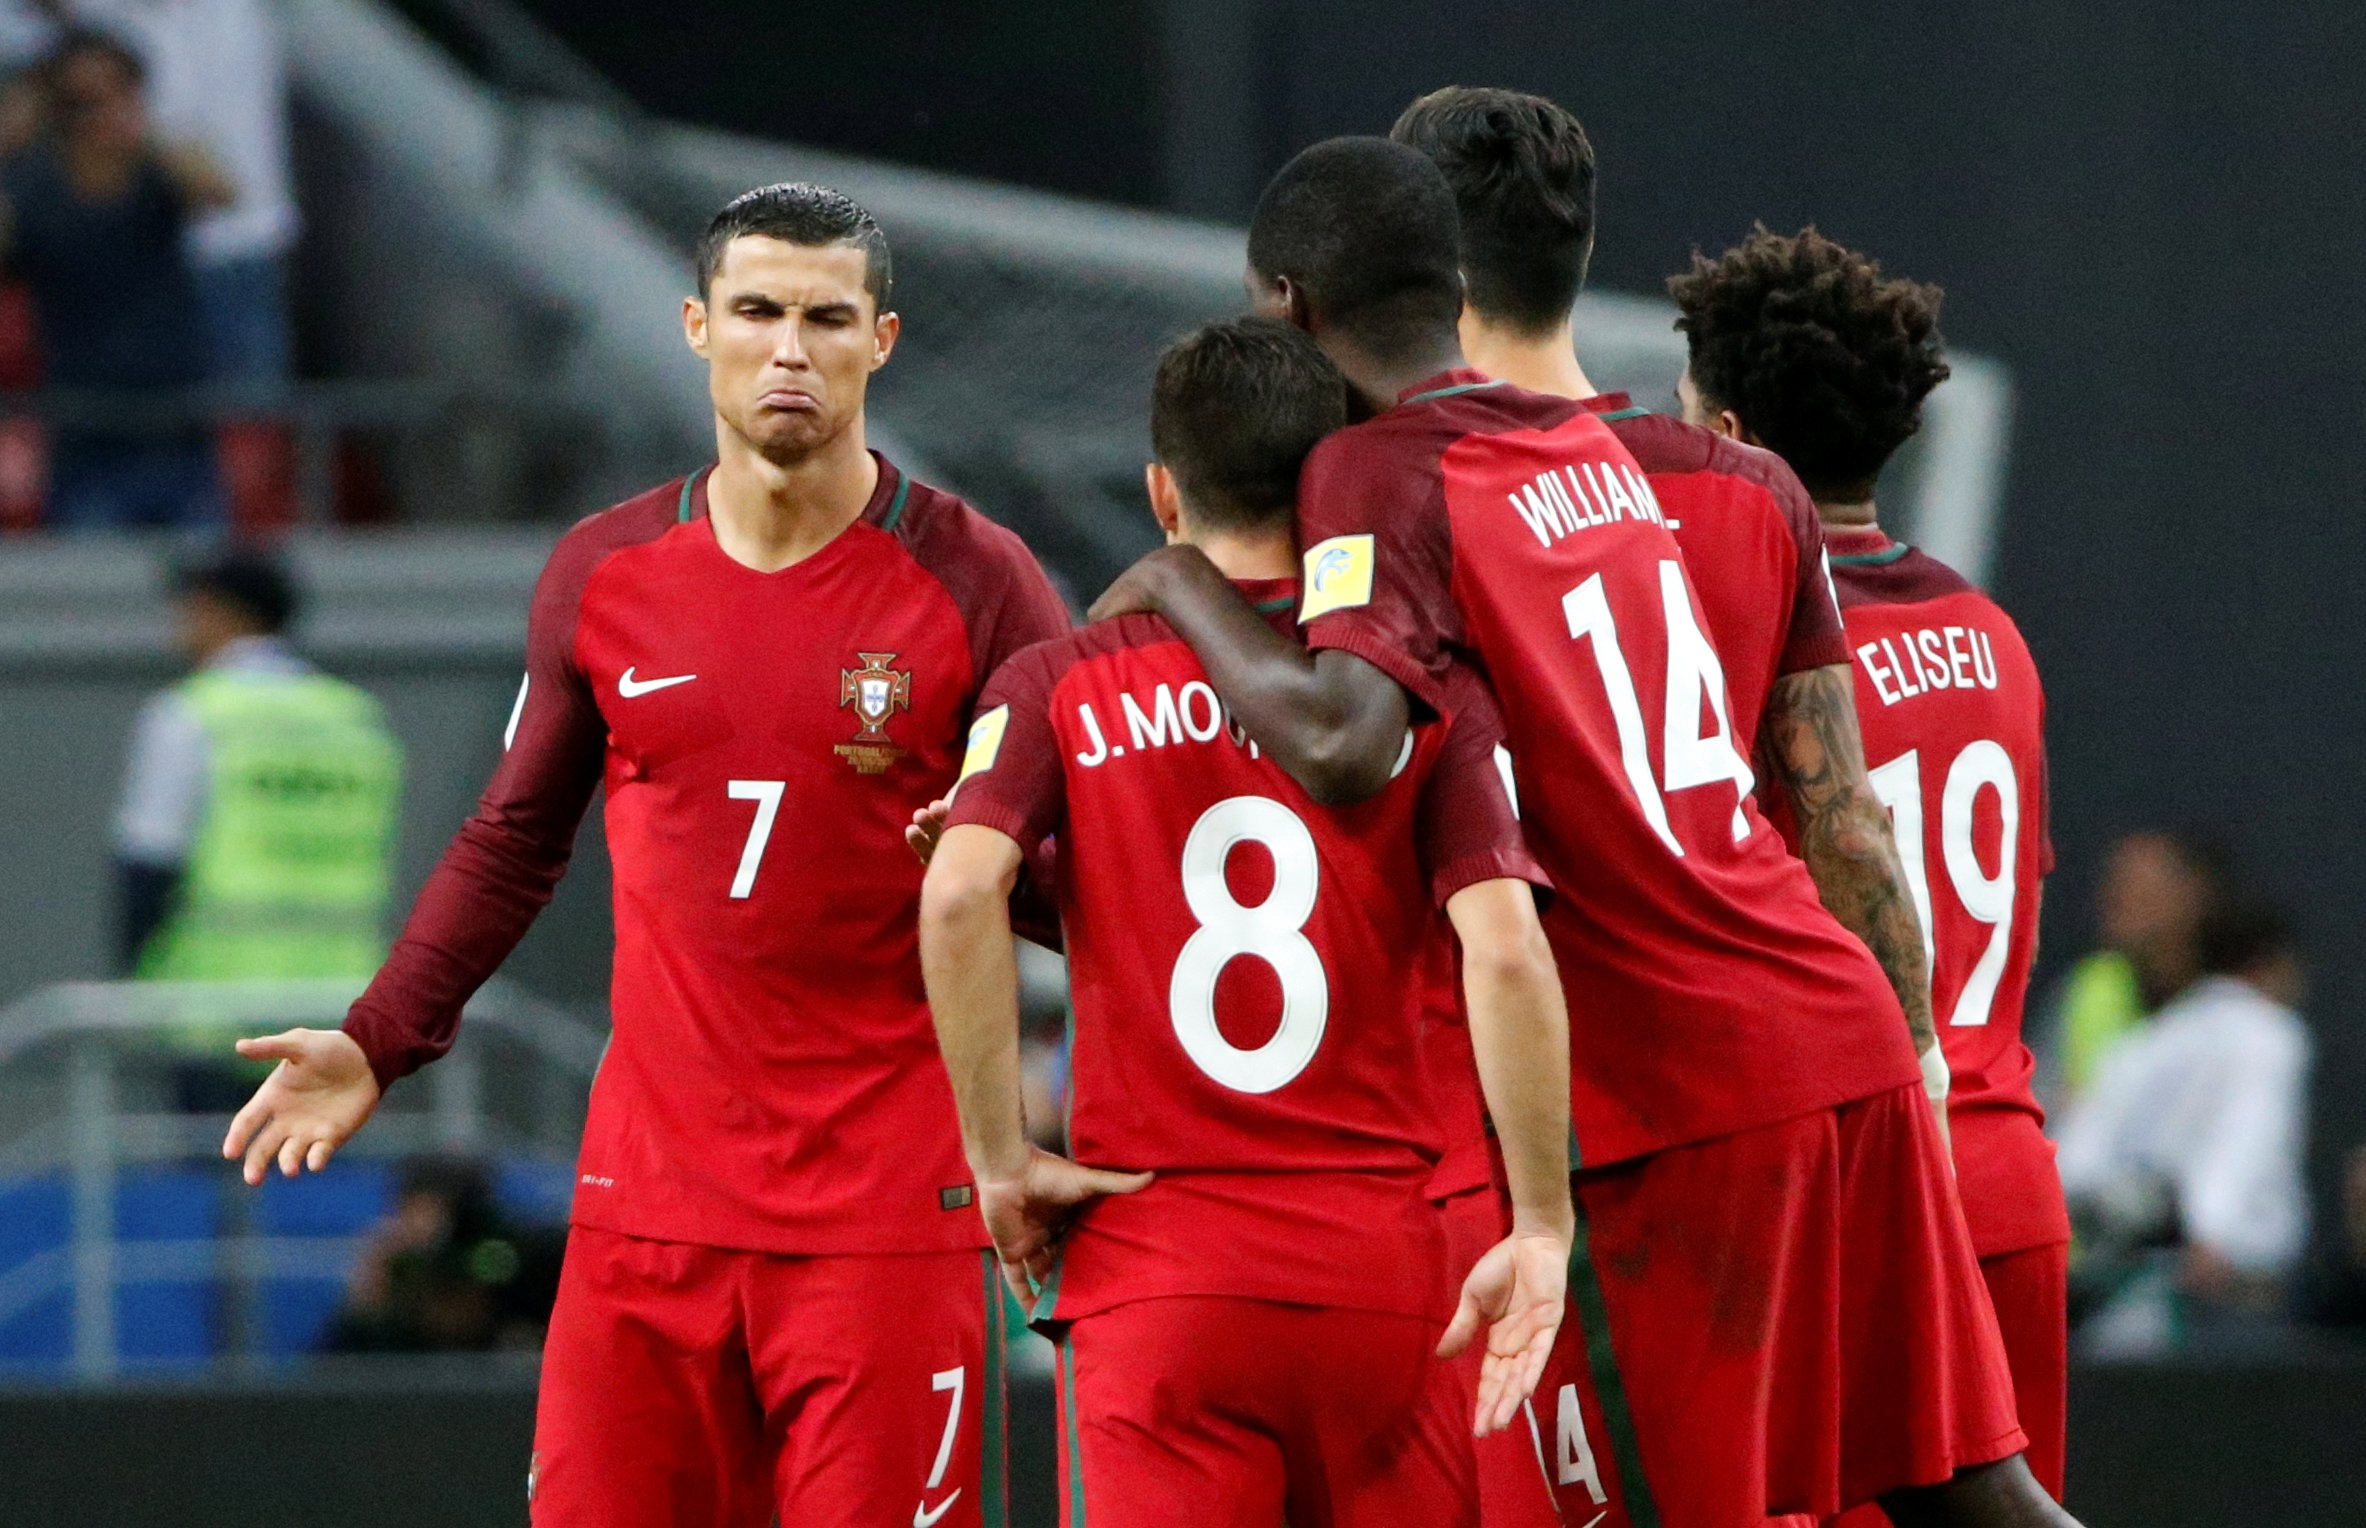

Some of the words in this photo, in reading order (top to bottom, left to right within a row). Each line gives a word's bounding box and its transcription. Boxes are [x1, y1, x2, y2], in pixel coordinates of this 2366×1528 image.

[1562, 559, 1756, 857] 14
[1856, 626, 1998, 706] ELISEU
[727, 779, 787, 900] 7
[1867, 739, 2018, 1026] 19
[1169, 795, 1329, 1094] 8
[926, 1365, 965, 1489] 7
